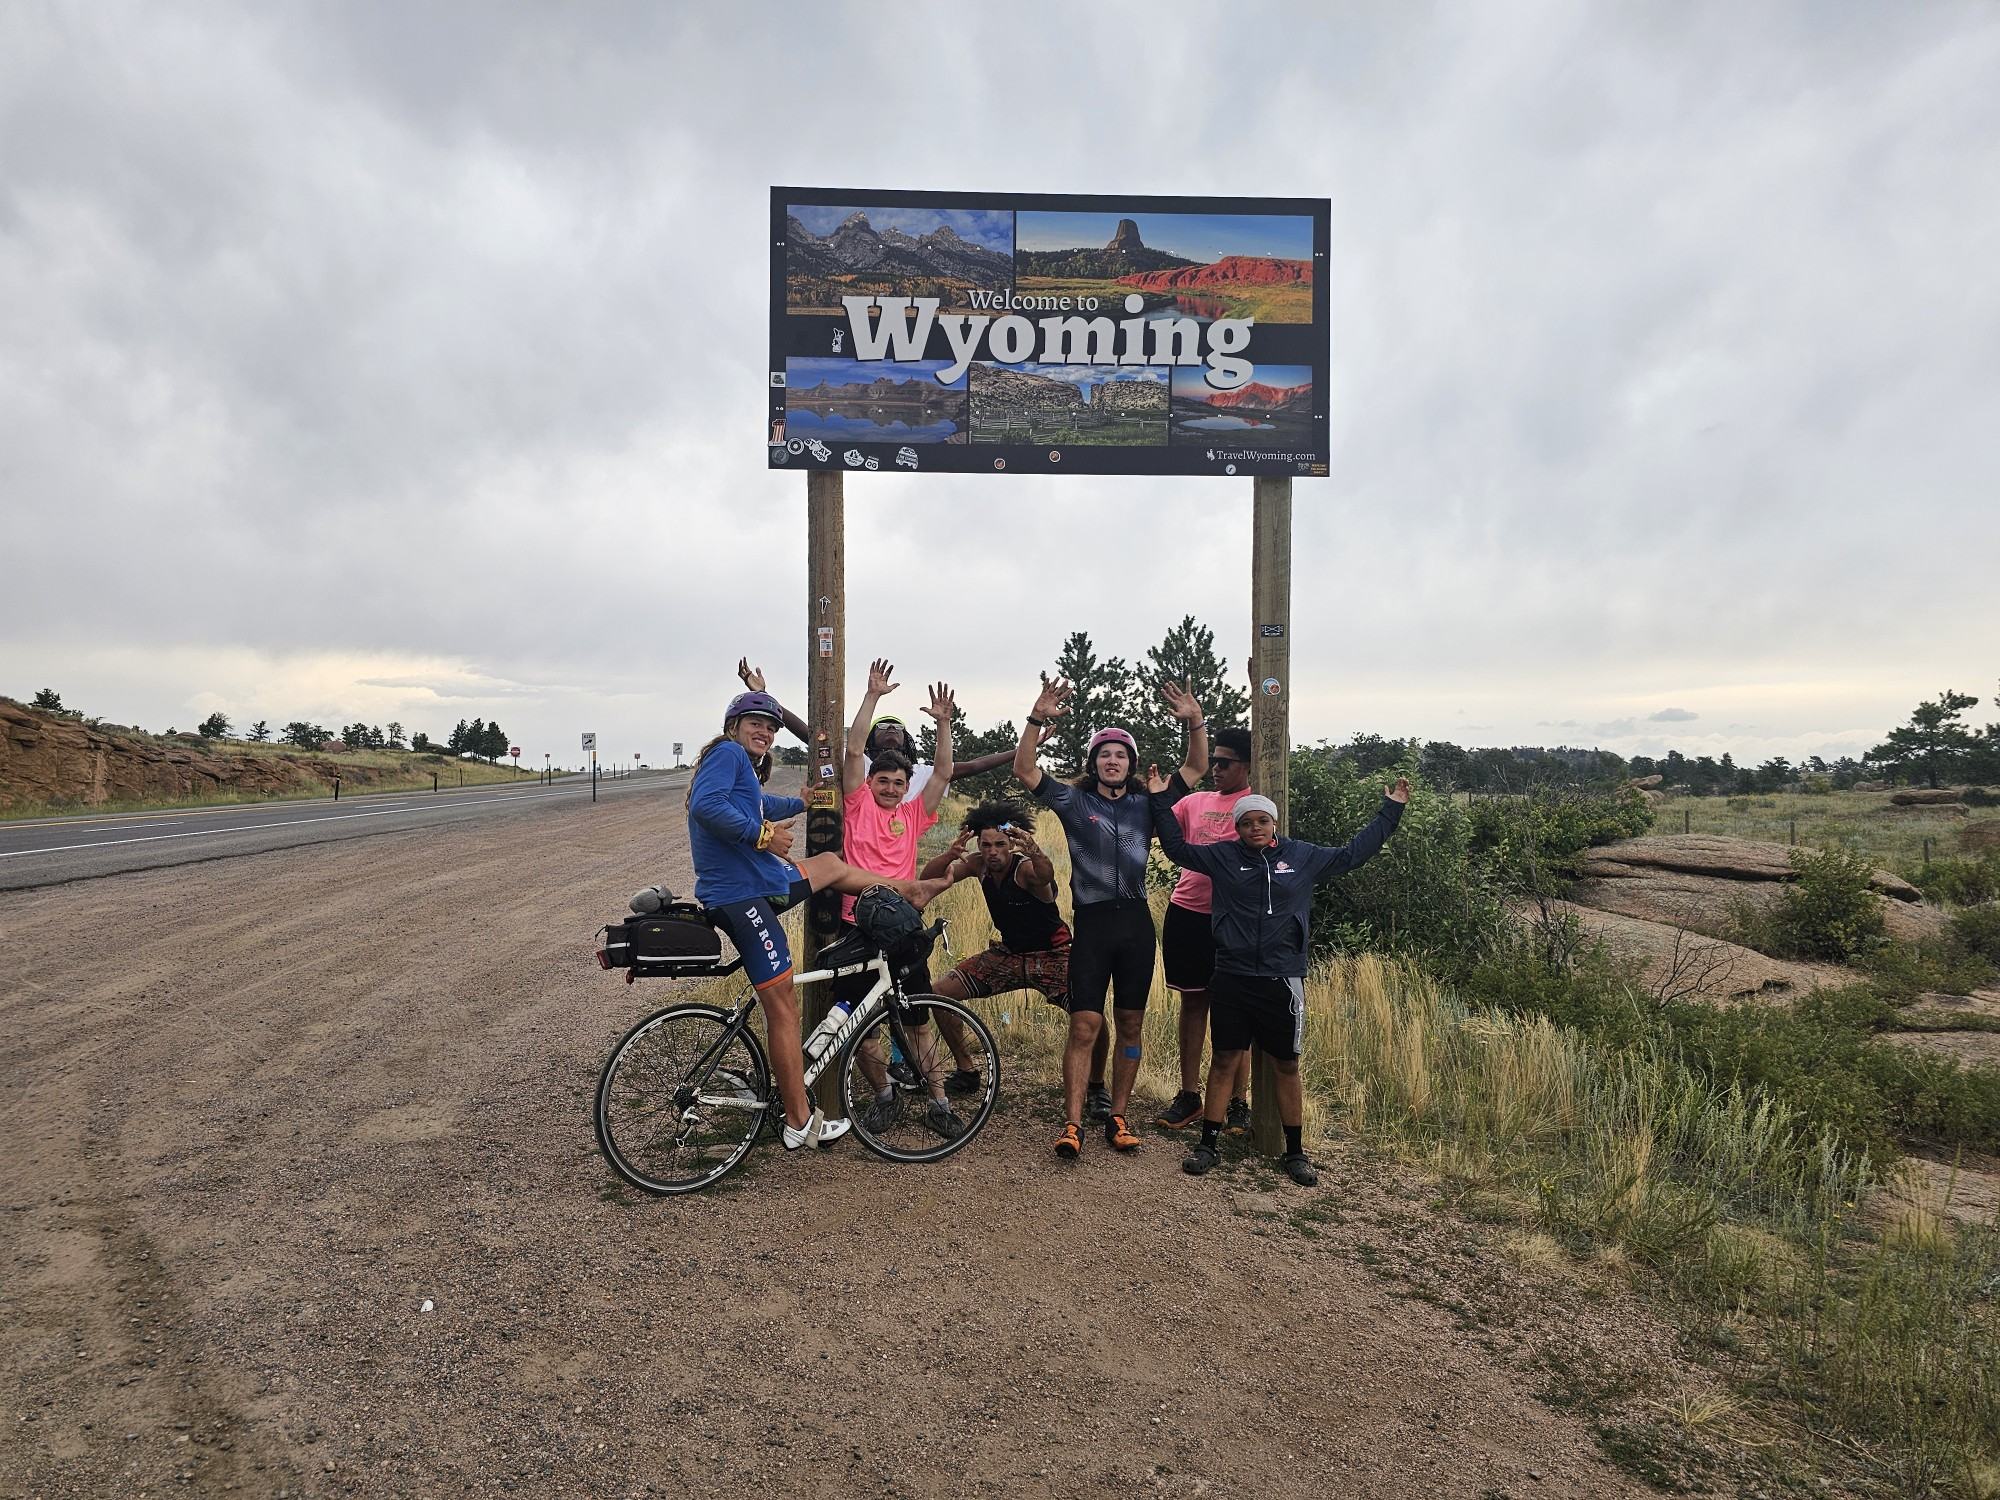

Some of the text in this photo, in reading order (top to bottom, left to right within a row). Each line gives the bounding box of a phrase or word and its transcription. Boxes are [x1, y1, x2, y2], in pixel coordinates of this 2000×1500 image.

[968, 289, 1099, 312] Welcome to
[842, 294, 1254, 388] Wyoming
[1217, 450, 1316, 462] TravelWyoming.com
[745, 906, 763, 927] DE
[758, 928, 781, 972] ROSA
[809, 1002, 867, 1077] SPECIALIZED
